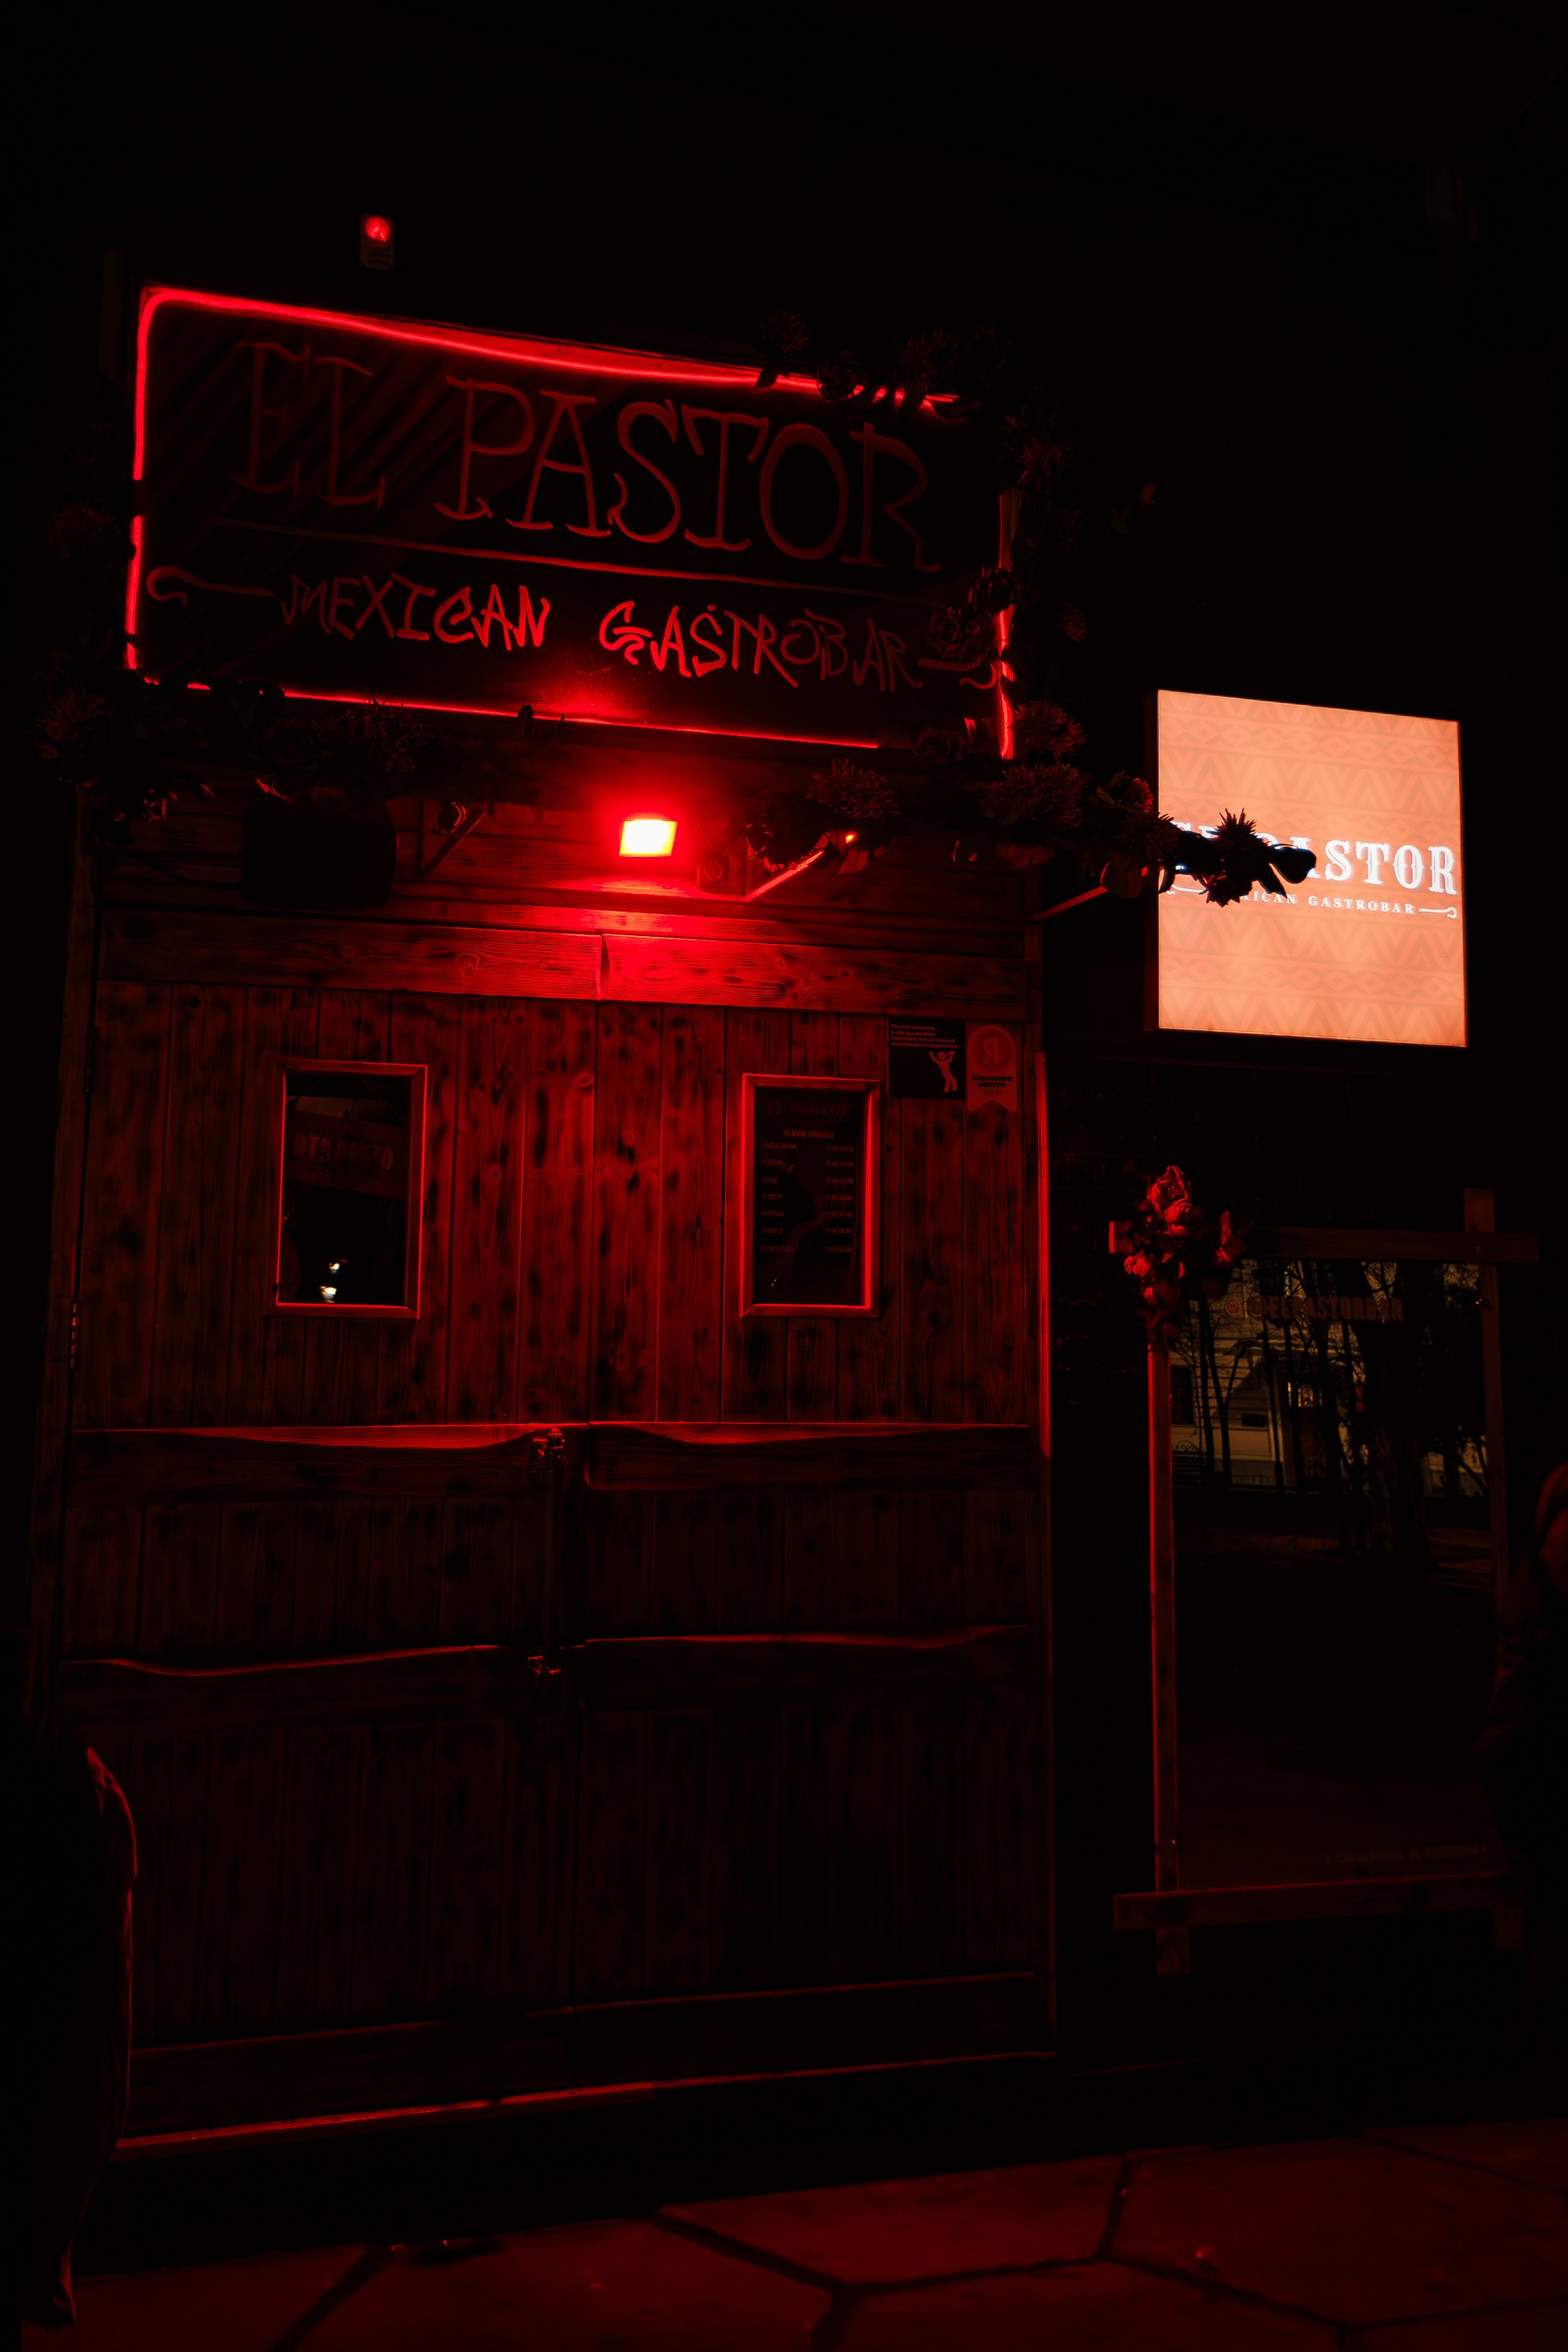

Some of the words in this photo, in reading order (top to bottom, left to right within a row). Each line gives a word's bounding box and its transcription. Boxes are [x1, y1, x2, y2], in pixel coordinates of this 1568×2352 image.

[228, 339, 387, 510] EL
[434, 374, 941, 573] PASTOR
[280, 570, 551, 652] MEXICAN
[598, 601, 923, 692] GASTROBAR
[1308, 896, 1415, 914] GASTROBAR
